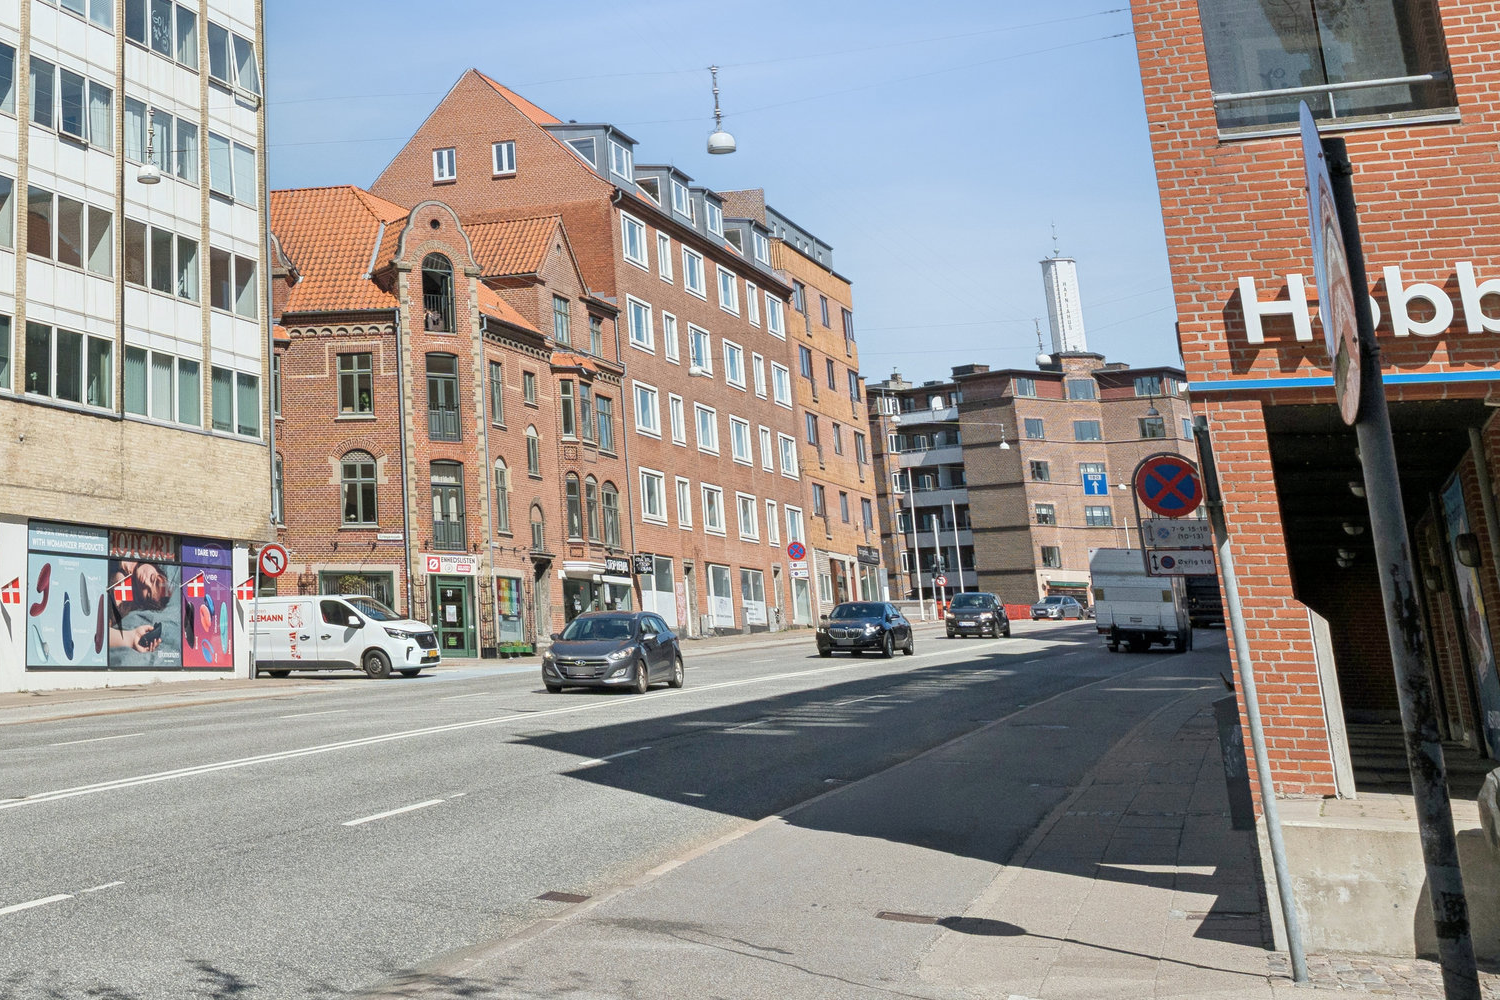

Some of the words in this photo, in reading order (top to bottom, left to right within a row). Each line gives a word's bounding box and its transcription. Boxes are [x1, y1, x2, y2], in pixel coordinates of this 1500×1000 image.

[1238, 261, 1500, 344] Hbb
[32, 538, 46, 547] WITH
[46, 538, 78, 549] WOMANIZER
[78, 542, 104, 552] PRODUCTS
[198, 549, 209, 557] DARE
[441, 556, 475, 564] ENHEDSLISTEN
[249, 614, 283, 623] LEMANN
